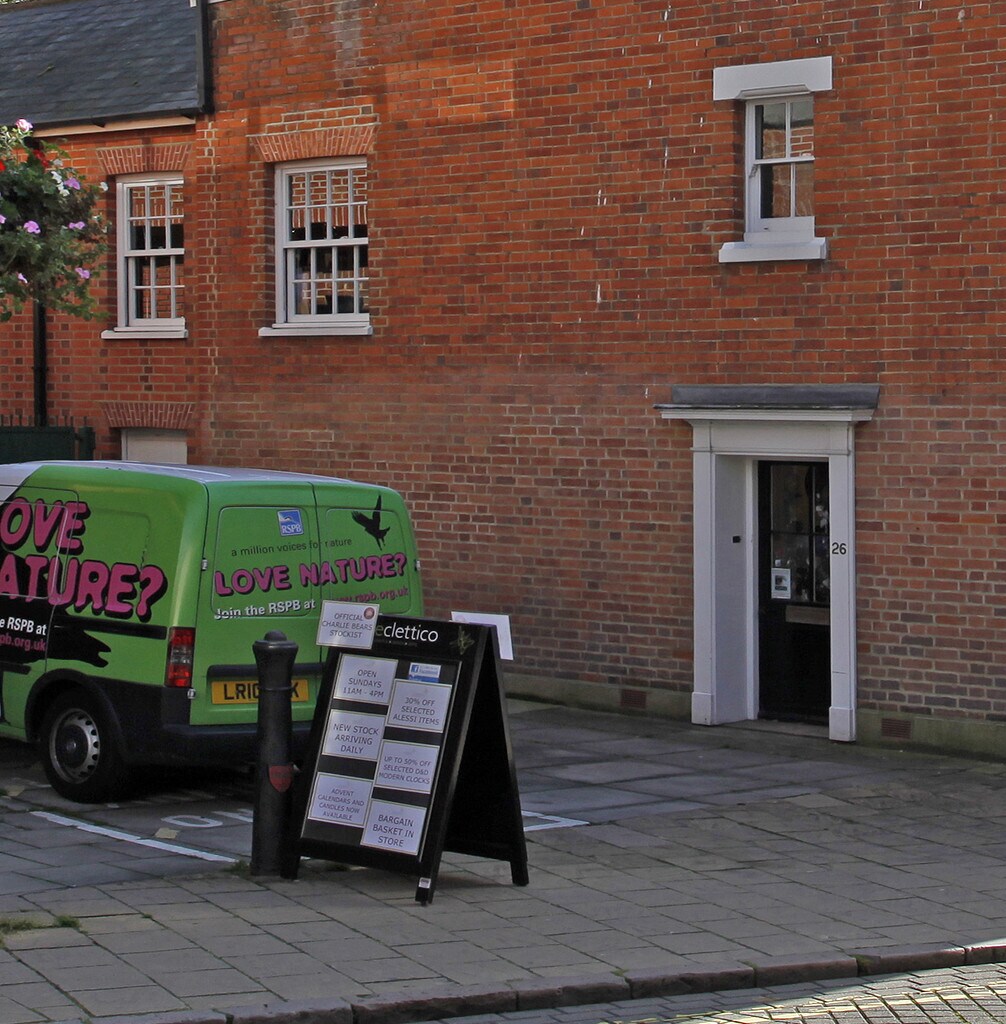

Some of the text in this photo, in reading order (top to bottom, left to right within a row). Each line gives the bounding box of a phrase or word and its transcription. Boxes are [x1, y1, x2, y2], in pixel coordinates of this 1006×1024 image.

[281, 525, 302, 534] RSPB
[231, 549, 237, 557] a
[240, 543, 274, 556] million
[277, 542, 306, 552] voices
[832, 542, 847, 555] 26
[214, 552, 407, 596] LOVE NATURE?
[214, 599, 315, 620] Join the RSPB at
[334, 613, 363, 621] OFFICIAL
[7, 616, 35, 633] RSPB
[36, 624, 47, 636] at
[322, 620, 373, 631] CHARLIE BEARS
[329, 629, 362, 638] STOCKIST
[376, 622, 439, 642] eclettico
[357, 669, 377, 678] OPEN
[348, 678, 382, 688] SUNDAYS
[343, 687, 362, 695] 11AM
[369, 689, 384, 698] 4PM
[405, 697, 436, 707] 30% OFF
[401, 706, 435, 716] SELECTED
[393, 713, 440, 725] ALESSI ITEMS
[333, 724, 379, 736] NEW STOCK
[335, 734, 373, 745] ARRIVING
[340, 745, 364, 754] DAILY
[383, 765, 413, 775] SELECTED
[379, 772, 430, 784] MODERN CLOCKS
[331, 788, 354, 797] ADVENT
[318, 794, 365, 807] CALENDARS AND
[319, 802, 360, 814] CANDLES NOW
[322, 811, 353, 821] AVAILABLE
[378, 814, 414, 827] BARGAIN
[372, 824, 414, 838] BASKET IN
[378, 836, 404, 847] STORE
